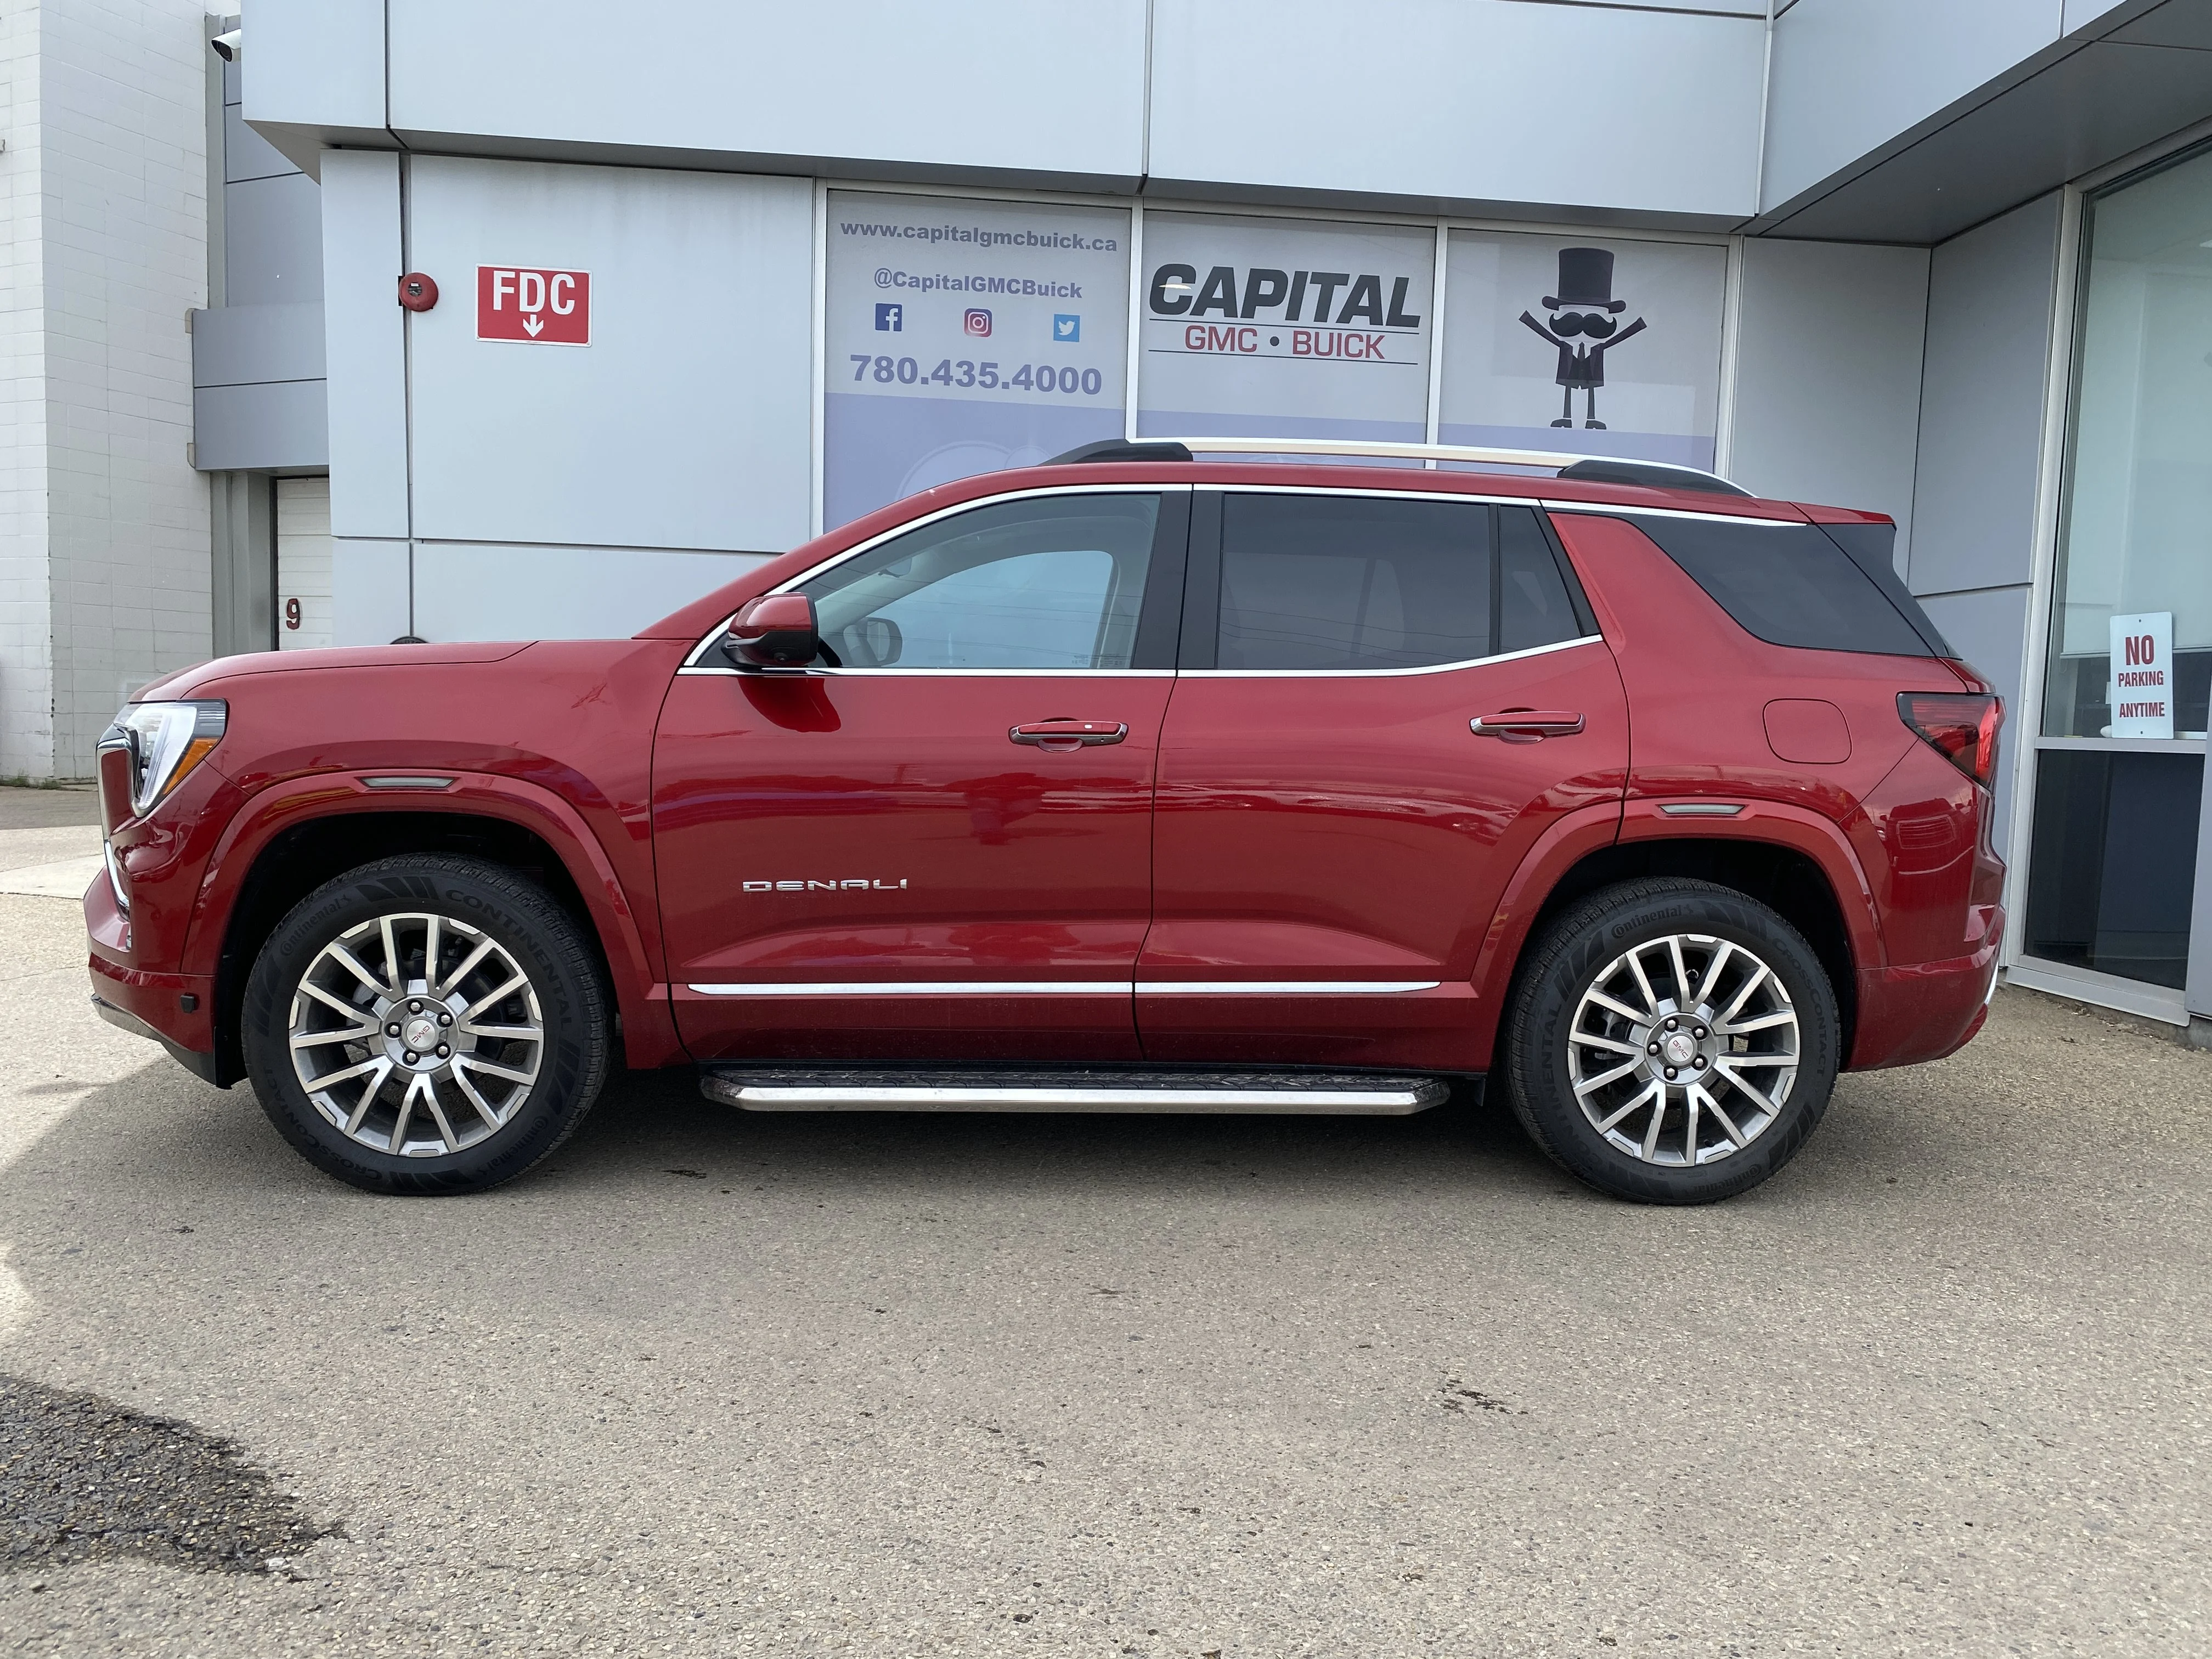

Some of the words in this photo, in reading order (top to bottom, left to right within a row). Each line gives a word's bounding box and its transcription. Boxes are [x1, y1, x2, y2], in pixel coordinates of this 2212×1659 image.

[840, 222, 1118, 251] www.capitalgmcbuick.ca
[493, 270, 575, 315] FDC
[874, 267, 1083, 298] @CapitalGMCBuick
[1149, 263, 1421, 328] CAPITAL
[1185, 325, 1258, 353] GMC
[1292, 330, 1386, 360] BUICK
[850, 354, 1102, 395] 780.435.4000
[286, 597, 301, 630] 9
[2125, 634, 2155, 666] NO
[2118, 670, 2164, 687] PARKING
[2119, 702, 2165, 718] ANYTIME
[742, 878, 907, 892] DENALI
[1611, 904, 1683, 939] Continental
[411, 1025, 430, 1043] GMC
[1672, 1040, 1689, 1059] GMC
